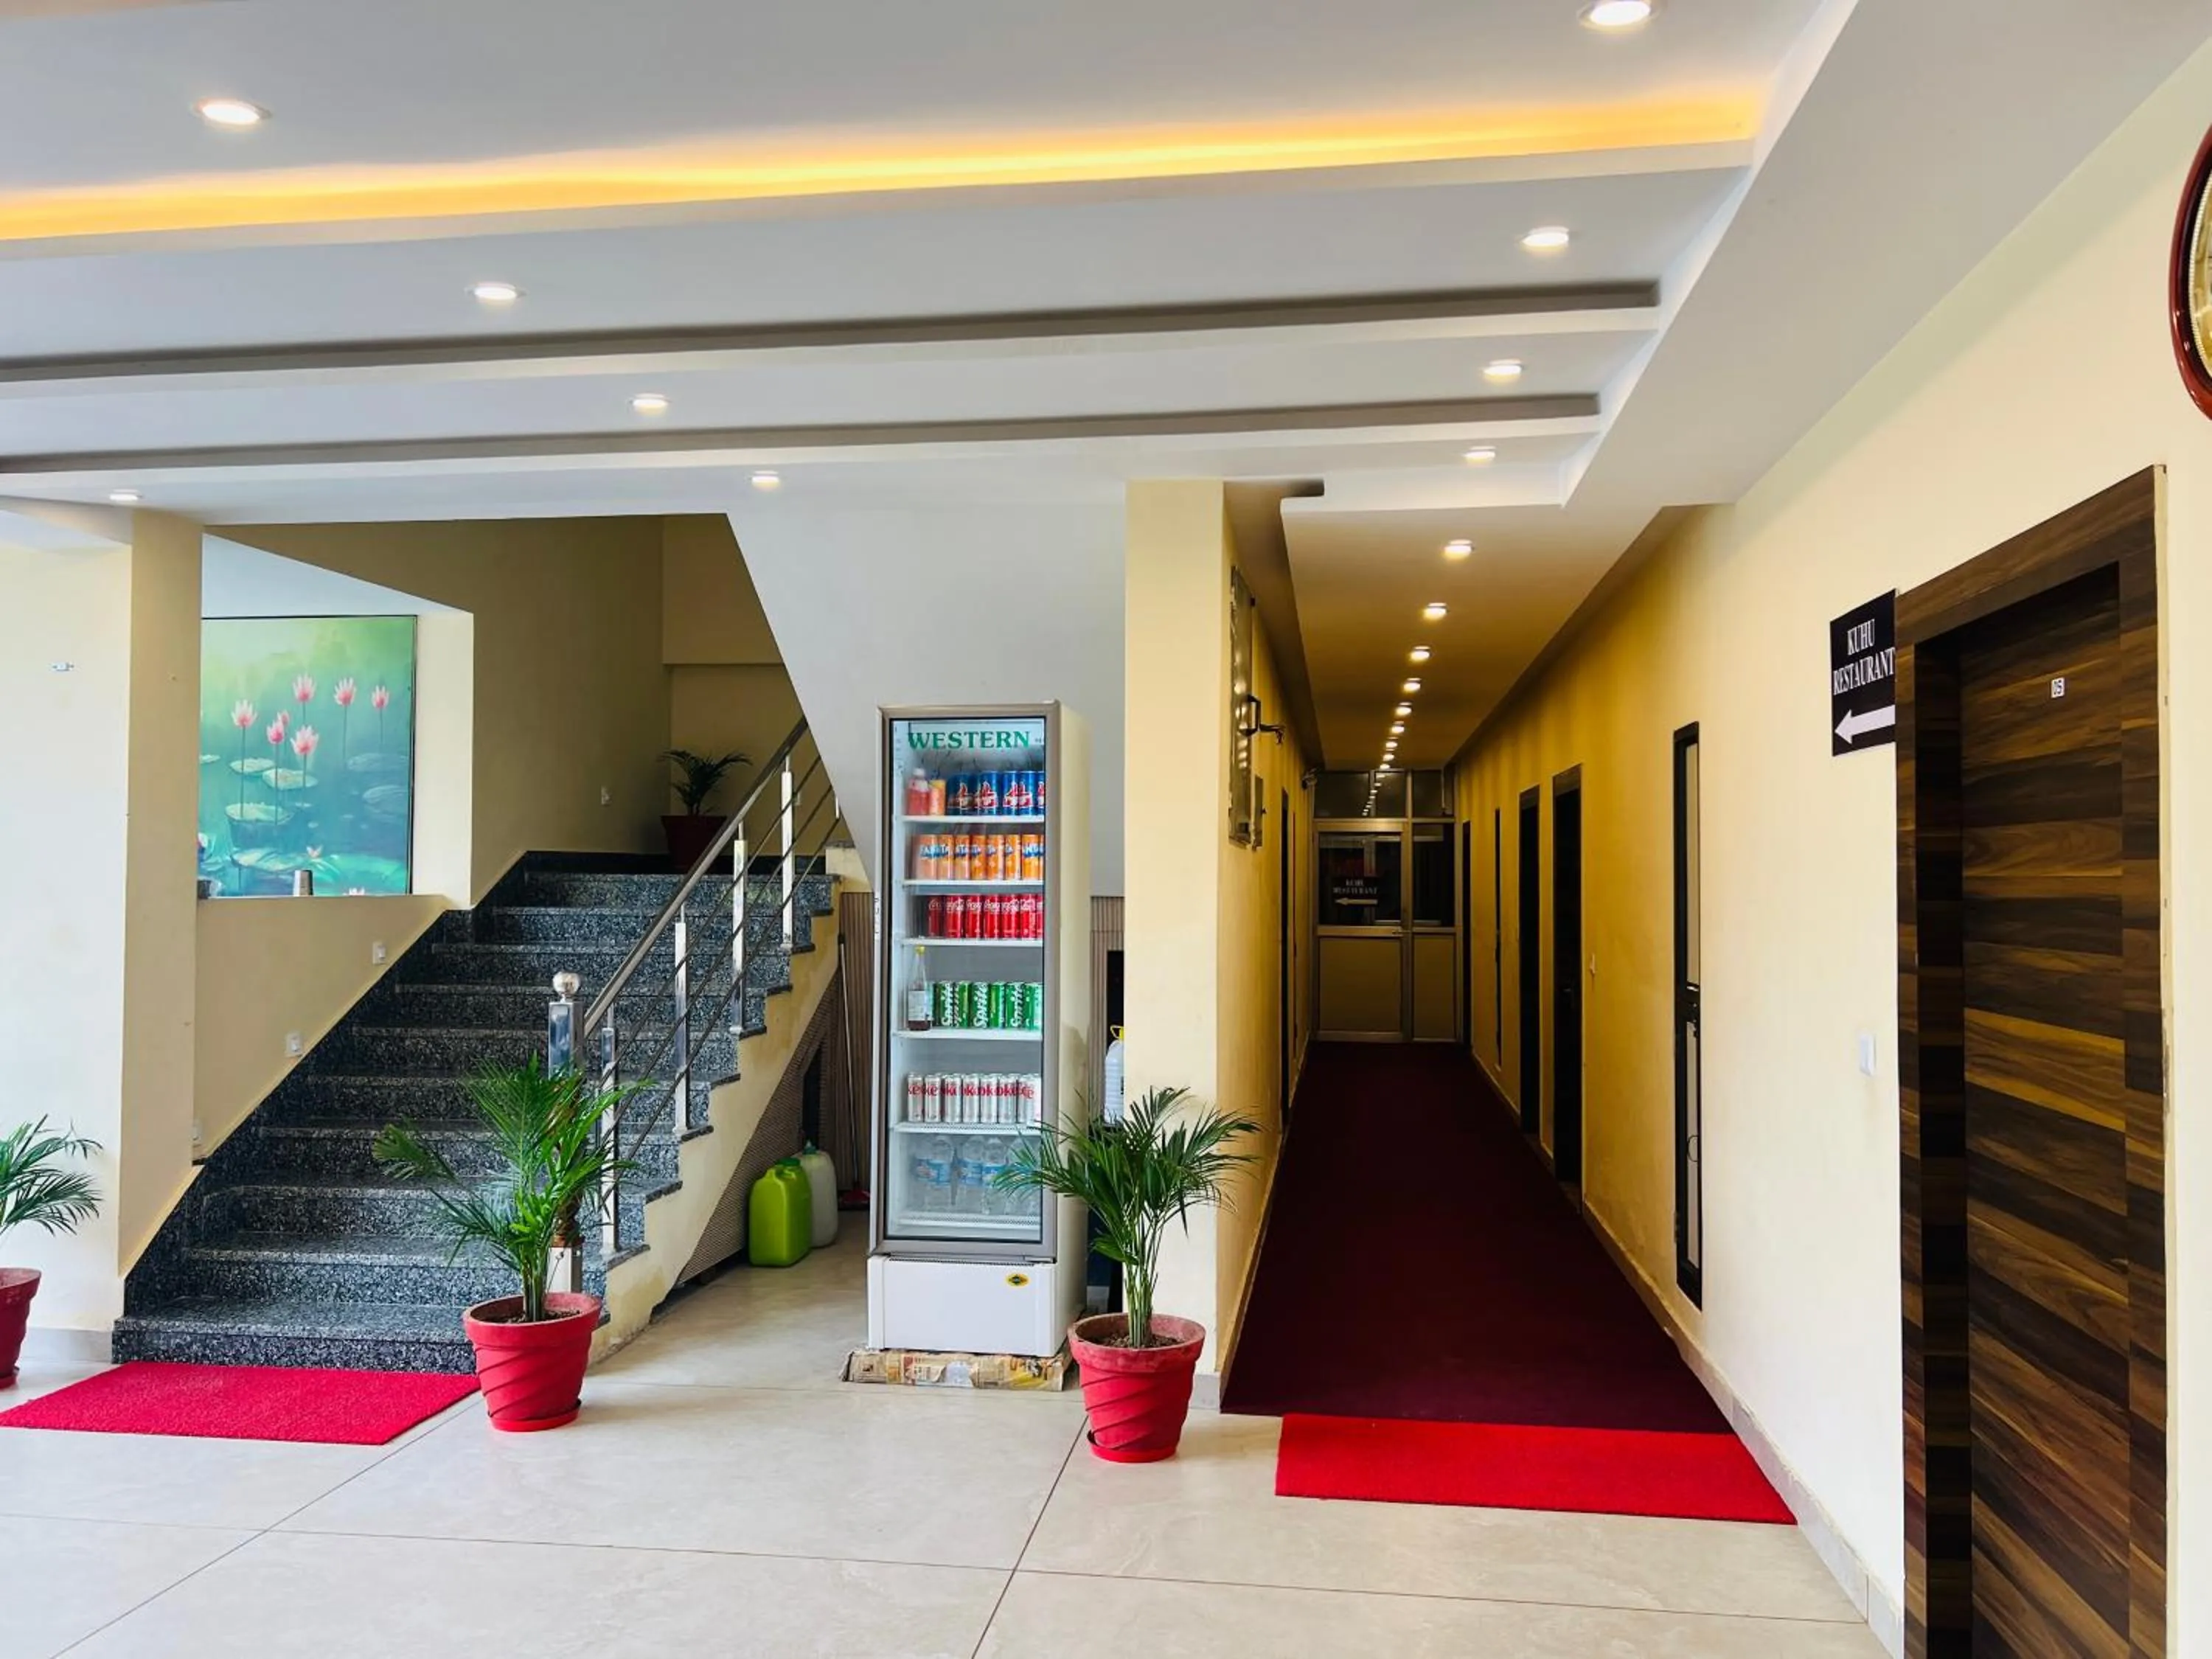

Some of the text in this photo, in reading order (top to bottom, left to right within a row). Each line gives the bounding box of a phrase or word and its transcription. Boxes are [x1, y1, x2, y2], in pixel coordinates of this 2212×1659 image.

[1847, 619, 1875, 655] KUHU
[1833, 647, 1896, 695] RESTAURANT
[908, 730, 1030, 750] WESTERN
